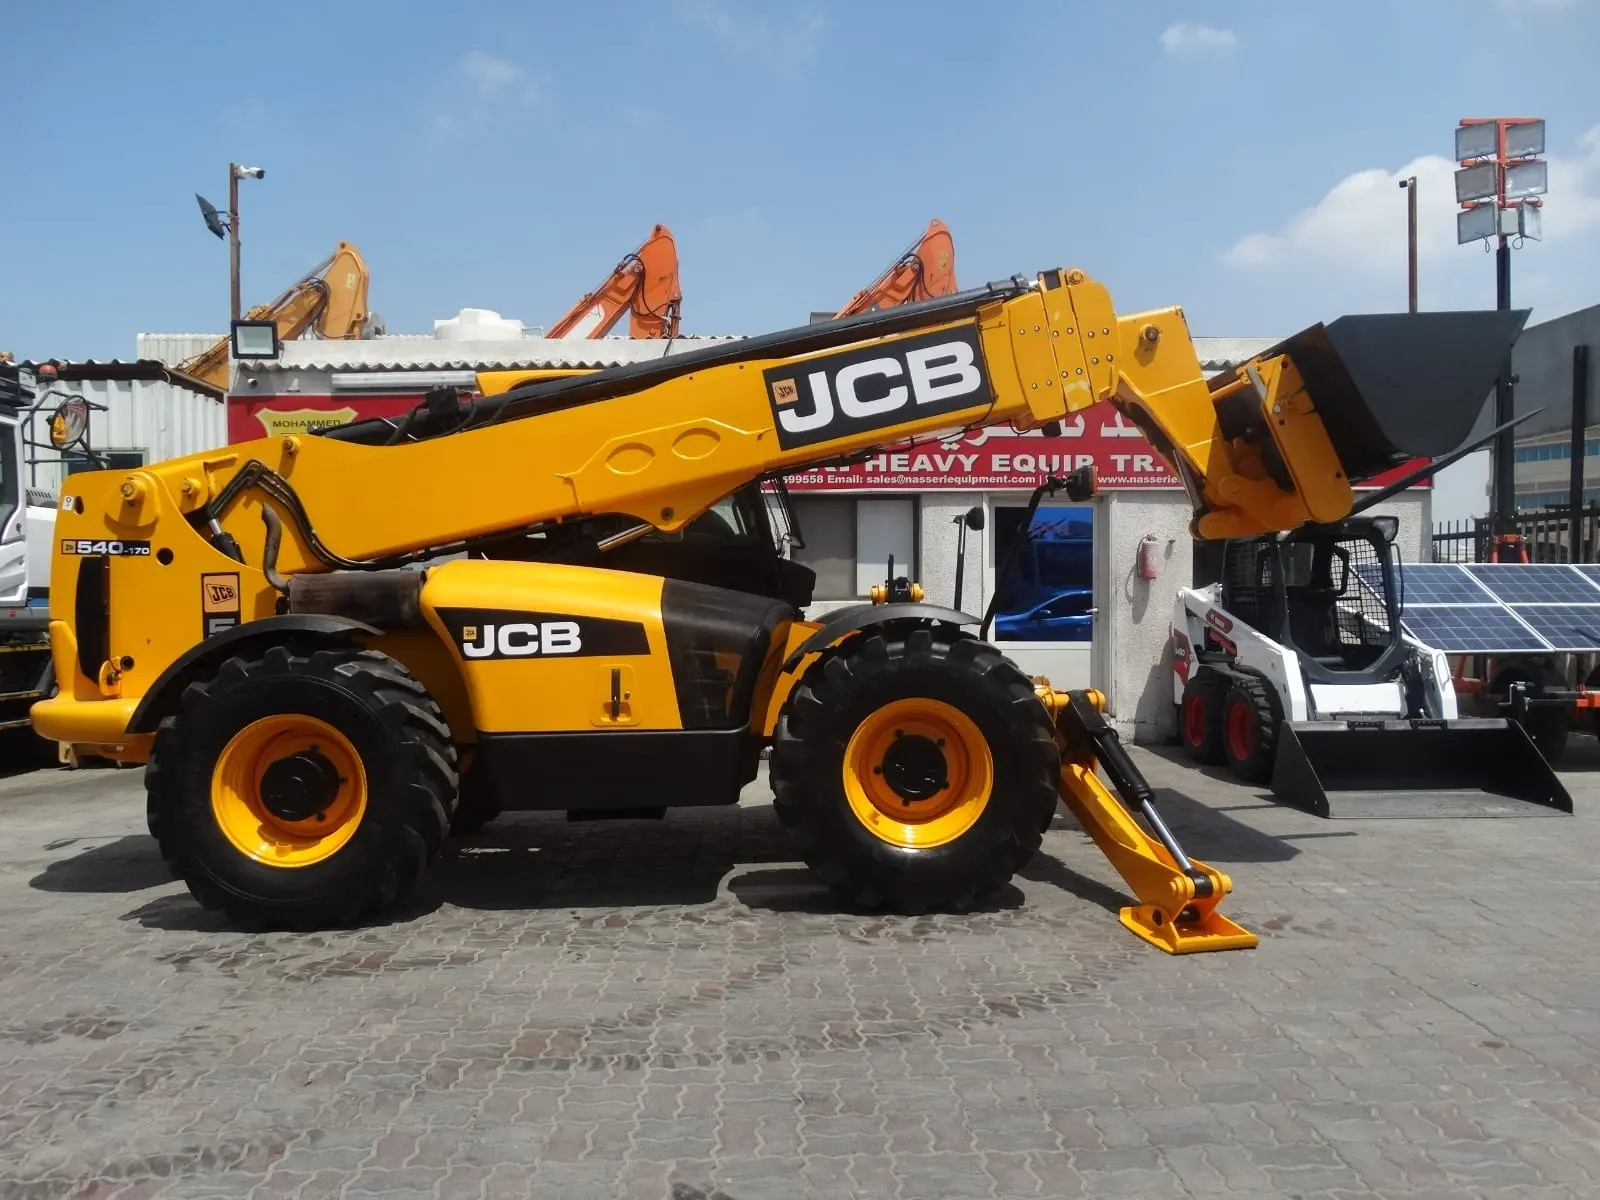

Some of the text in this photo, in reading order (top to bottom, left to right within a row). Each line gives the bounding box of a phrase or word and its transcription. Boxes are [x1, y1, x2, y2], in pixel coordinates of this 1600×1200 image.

[778, 341, 981, 433] JCB
[865, 454, 979, 472] HEAVY
[1110, 454, 1164, 472] TR.
[827, 474, 863, 484] Email:
[866, 474, 1036, 485] sales@nasseriequipment.com
[211, 585, 234, 602] JCB
[463, 621, 582, 658] JCB
